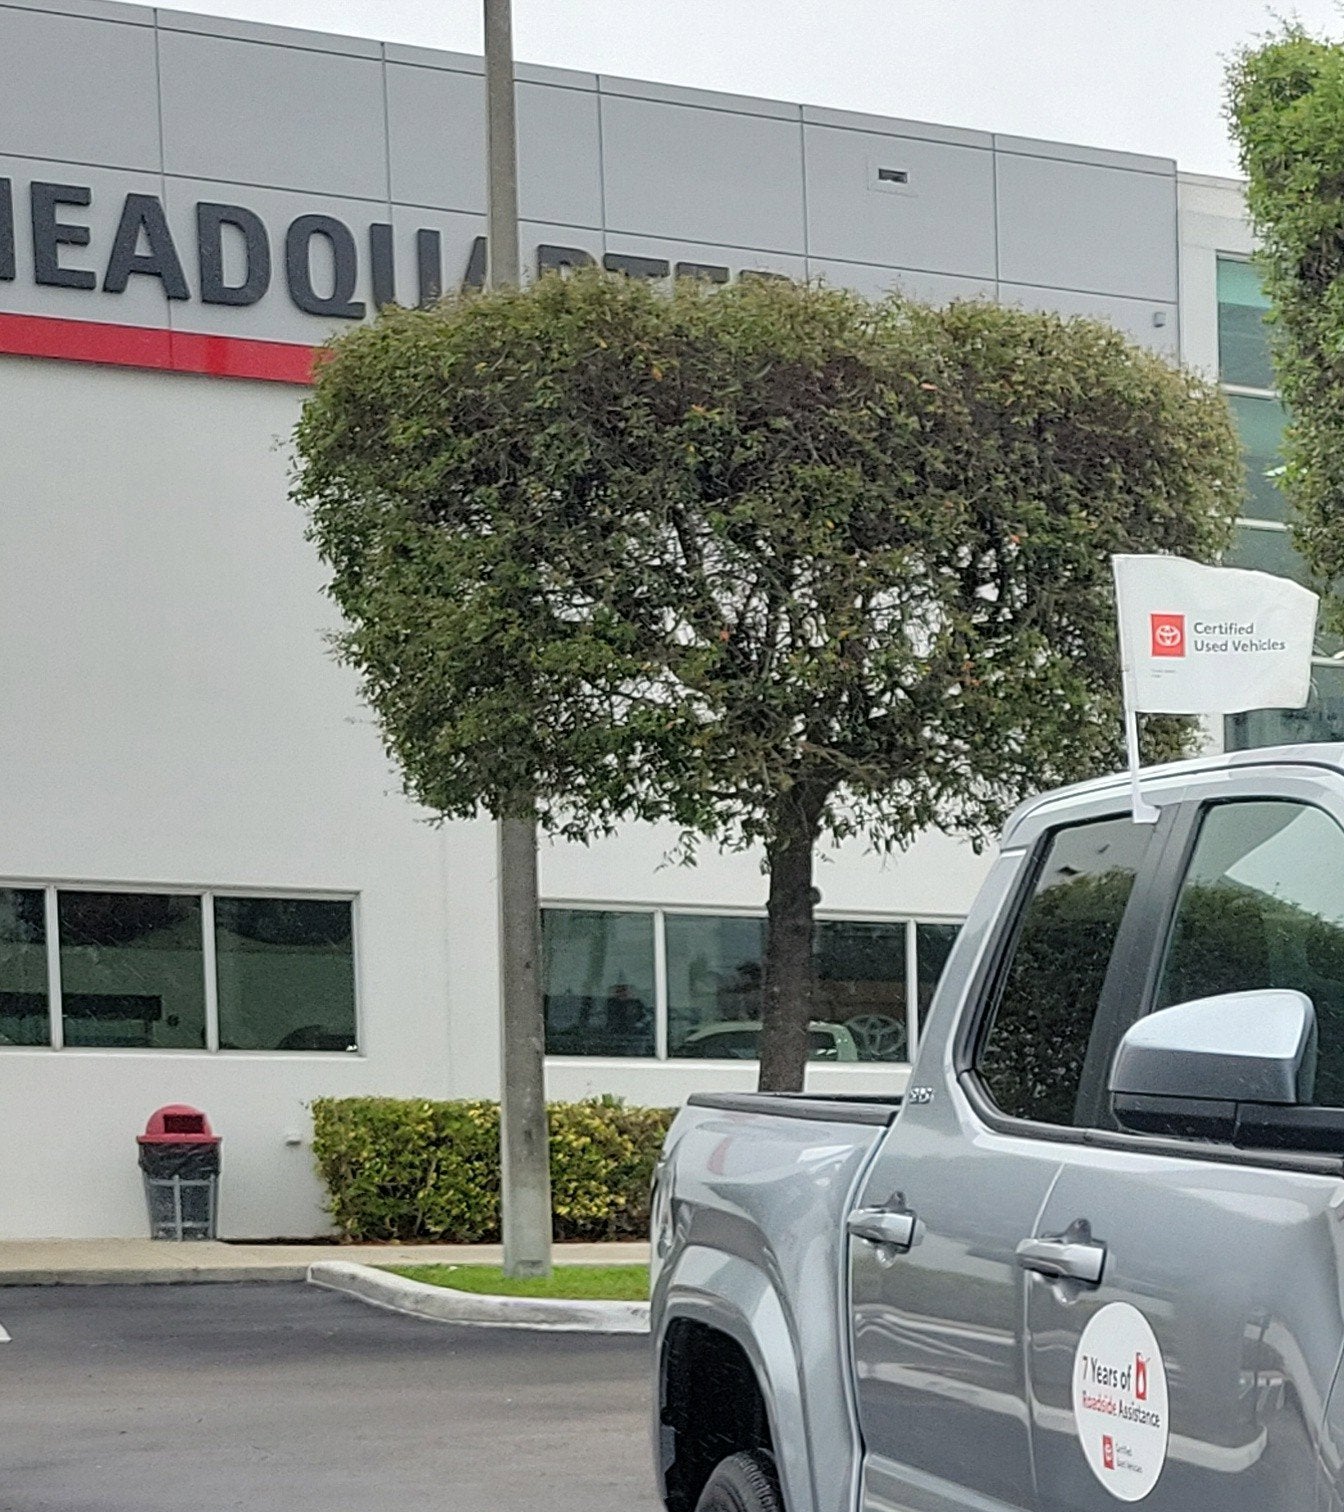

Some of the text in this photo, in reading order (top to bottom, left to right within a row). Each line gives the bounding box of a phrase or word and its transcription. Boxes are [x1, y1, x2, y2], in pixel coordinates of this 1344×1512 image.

[1193, 621, 1254, 635] Certified
[1193, 638, 1287, 652] Used Vehicles
[1082, 1355, 1132, 1391] 7 Years of
[1118, 1399, 1160, 1428] Assistance
